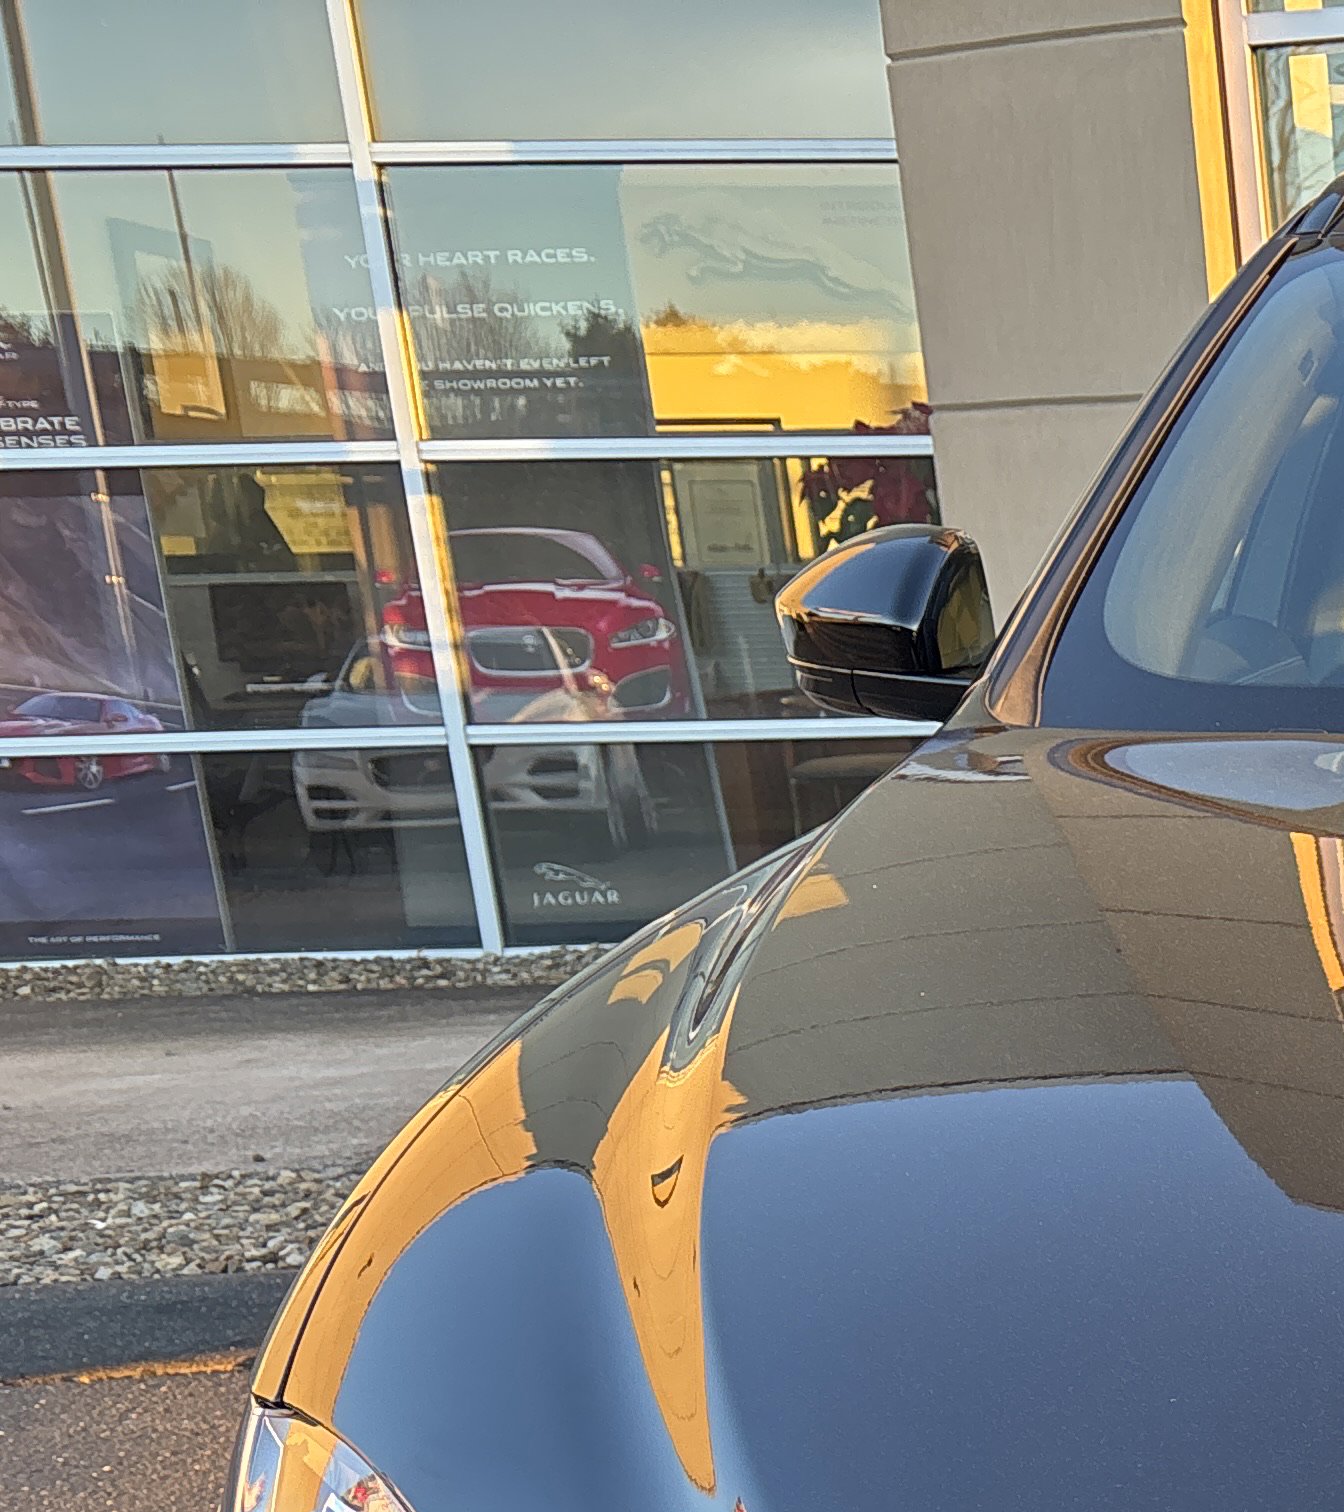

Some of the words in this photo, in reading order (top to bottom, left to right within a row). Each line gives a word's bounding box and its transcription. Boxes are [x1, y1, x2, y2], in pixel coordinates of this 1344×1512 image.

[418, 250, 500, 267] HEART
[507, 247, 597, 265] RACES.
[434, 378, 539, 390] SHOWROOM
[542, 376, 585, 389] YET.
[532, 889, 620, 909] JAGUAR
